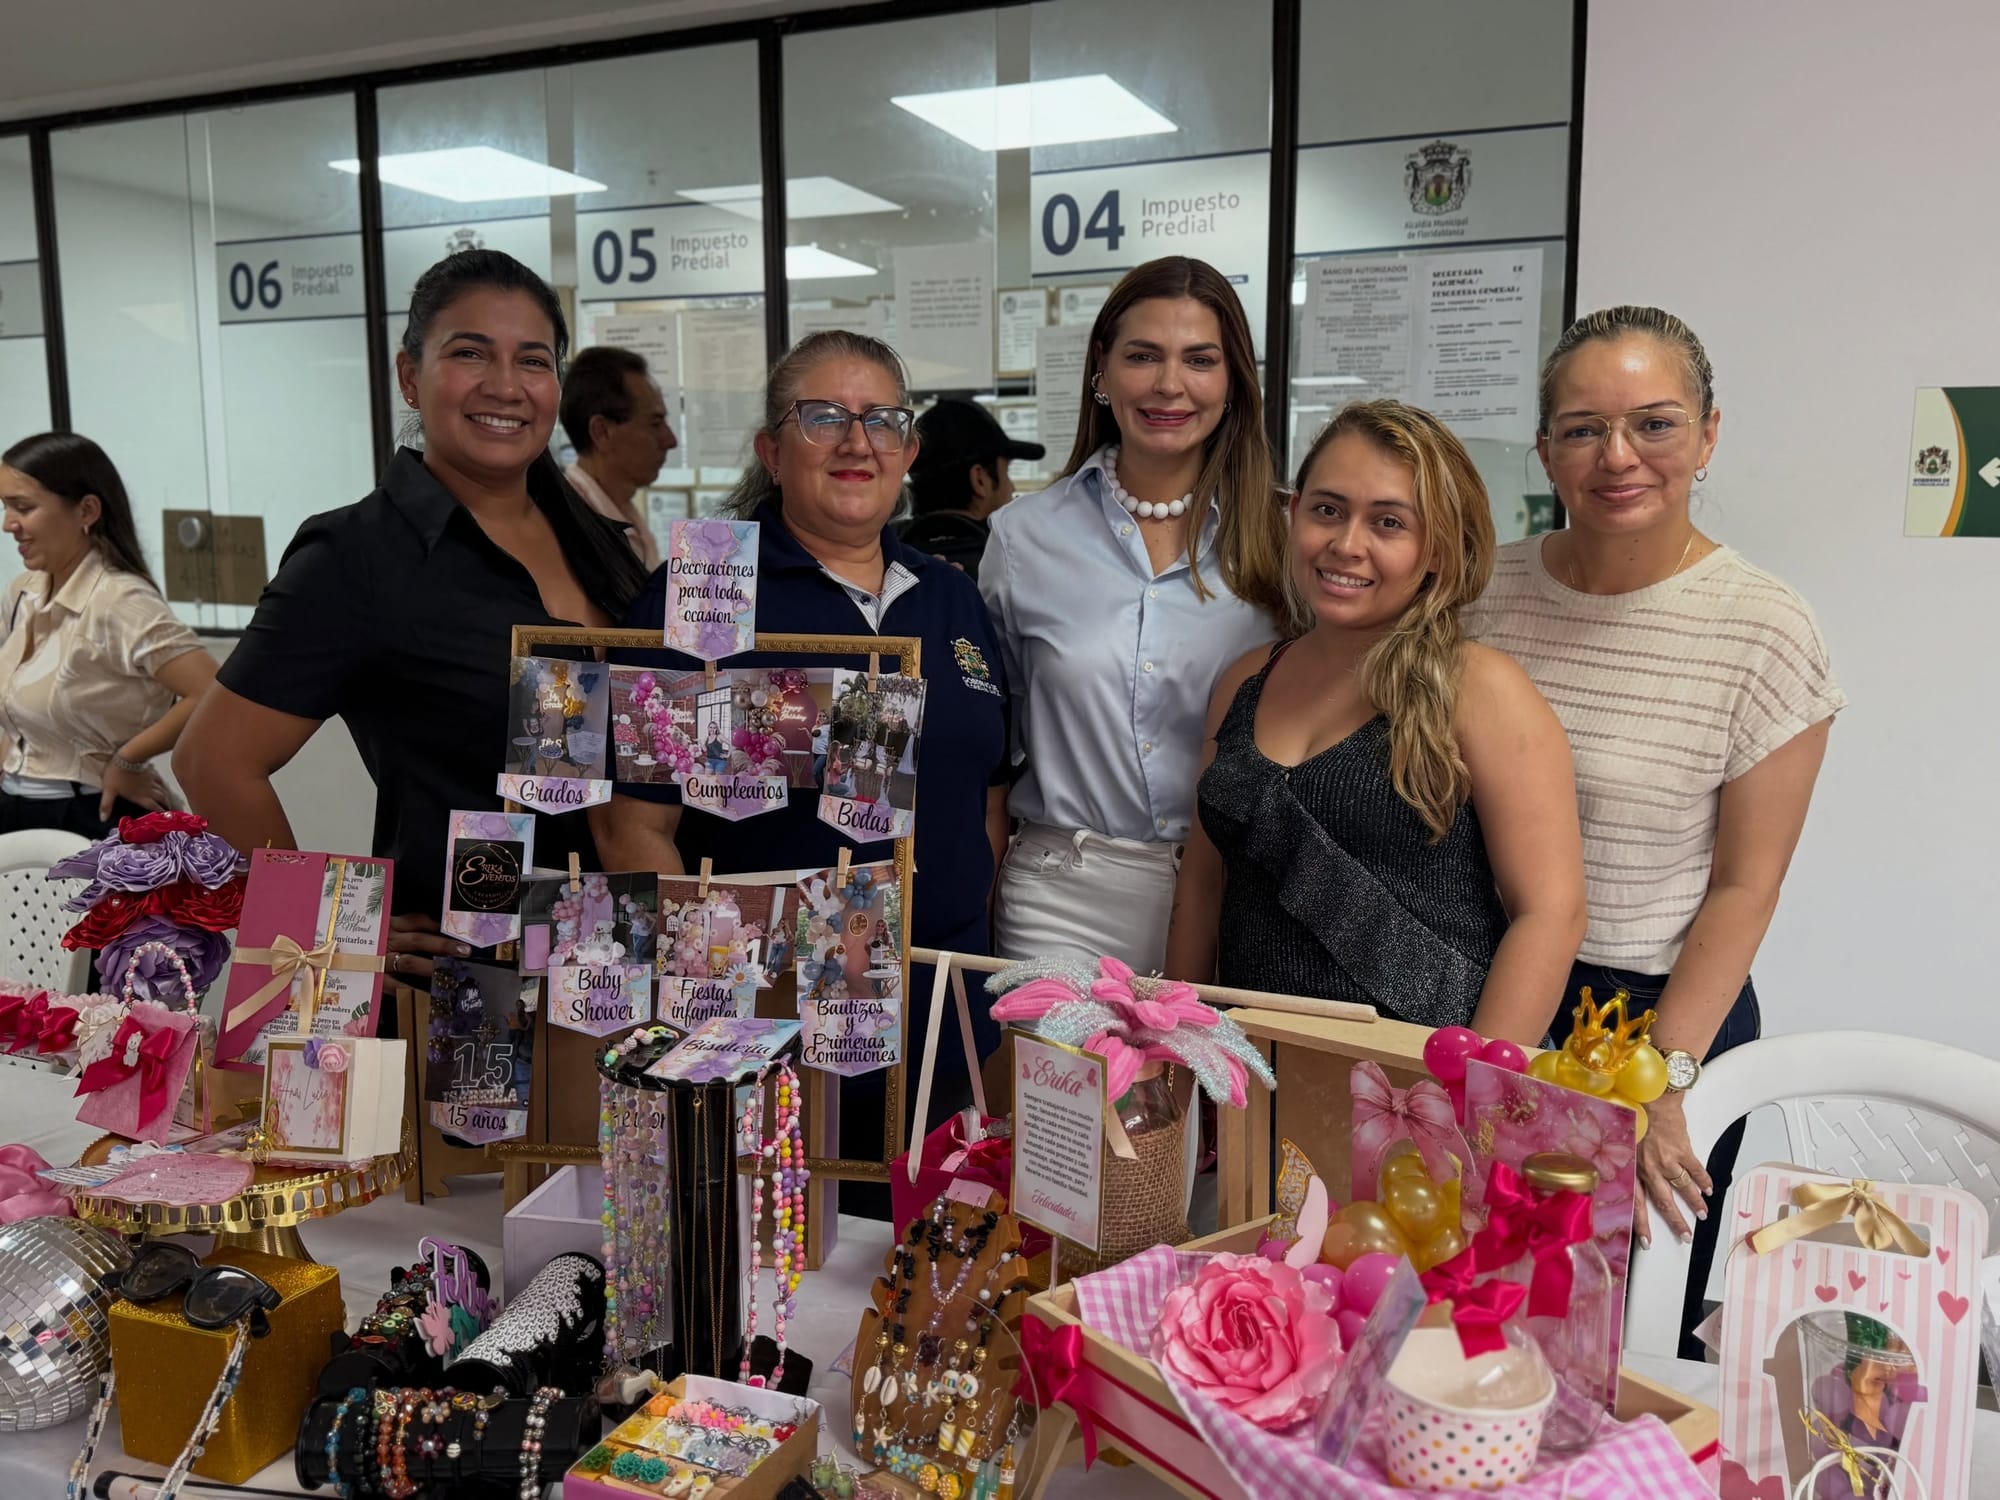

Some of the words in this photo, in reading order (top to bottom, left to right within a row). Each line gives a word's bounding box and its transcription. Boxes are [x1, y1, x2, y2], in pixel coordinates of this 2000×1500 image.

[1141, 192, 1240, 218] Impuesto
[1042, 189, 1125, 256] 04
[1141, 213, 1215, 238] Predial
[670, 233, 749, 253] Impuesto
[592, 228, 657, 285] 05
[671, 252, 730, 271] Predial
[291, 263, 354, 281] Impuesto
[1322, 267, 1353, 276] BANCOS
[1355, 265, 1408, 274] AUTORIZADOS
[1432, 269, 1484, 278] SECRETARIA
[1512, 265, 1524, 273] DE
[230, 260, 283, 311] 06
[292, 280, 340, 296] Predial
[1432, 279, 1474, 288] HACIENDA
[1432, 288, 1477, 298] TESORERIA
[670, 556, 755, 578] Decoraciones
[677, 585, 712, 606] para
[715, 581, 744, 601] toda
[519, 779, 585, 805] Grados
[686, 776, 785, 808] Cumpleaños
[837, 801, 892, 834] Bodas
[335, 935, 367, 945] invitarlos
[578, 966, 623, 1000] Baby
[680, 978, 734, 1001] Fiestas
[569, 997, 637, 1022] Shower
[671, 999, 738, 1028] infantiles
[817, 999, 885, 1023] Bautizos
[845, 1016, 855, 1036] y
[803, 1046, 896, 1065] Comuniones
[811, 1033, 887, 1056] Primeras
[451, 1042, 514, 1088] 15
[1034, 1056, 1083, 1097] Erika
[447, 1104, 469, 1128] 15
[472, 1110, 508, 1131] años
[1023, 1092, 1042, 1103] Siempre
[1042, 1099, 1068, 1113] trabajando
[1077, 1112, 1094, 1122] mucho
[1044, 1137, 1056, 1145] cada
[1046, 1119, 1057, 1127] cada
[1077, 1131, 1089, 1140] cada
[1037, 1162, 1052, 1172] mucho
[1074, 1178, 1085, 1187] para
[1077, 1160, 1089, 1169] cada
[1032, 1188, 1078, 1221] Felicidades
